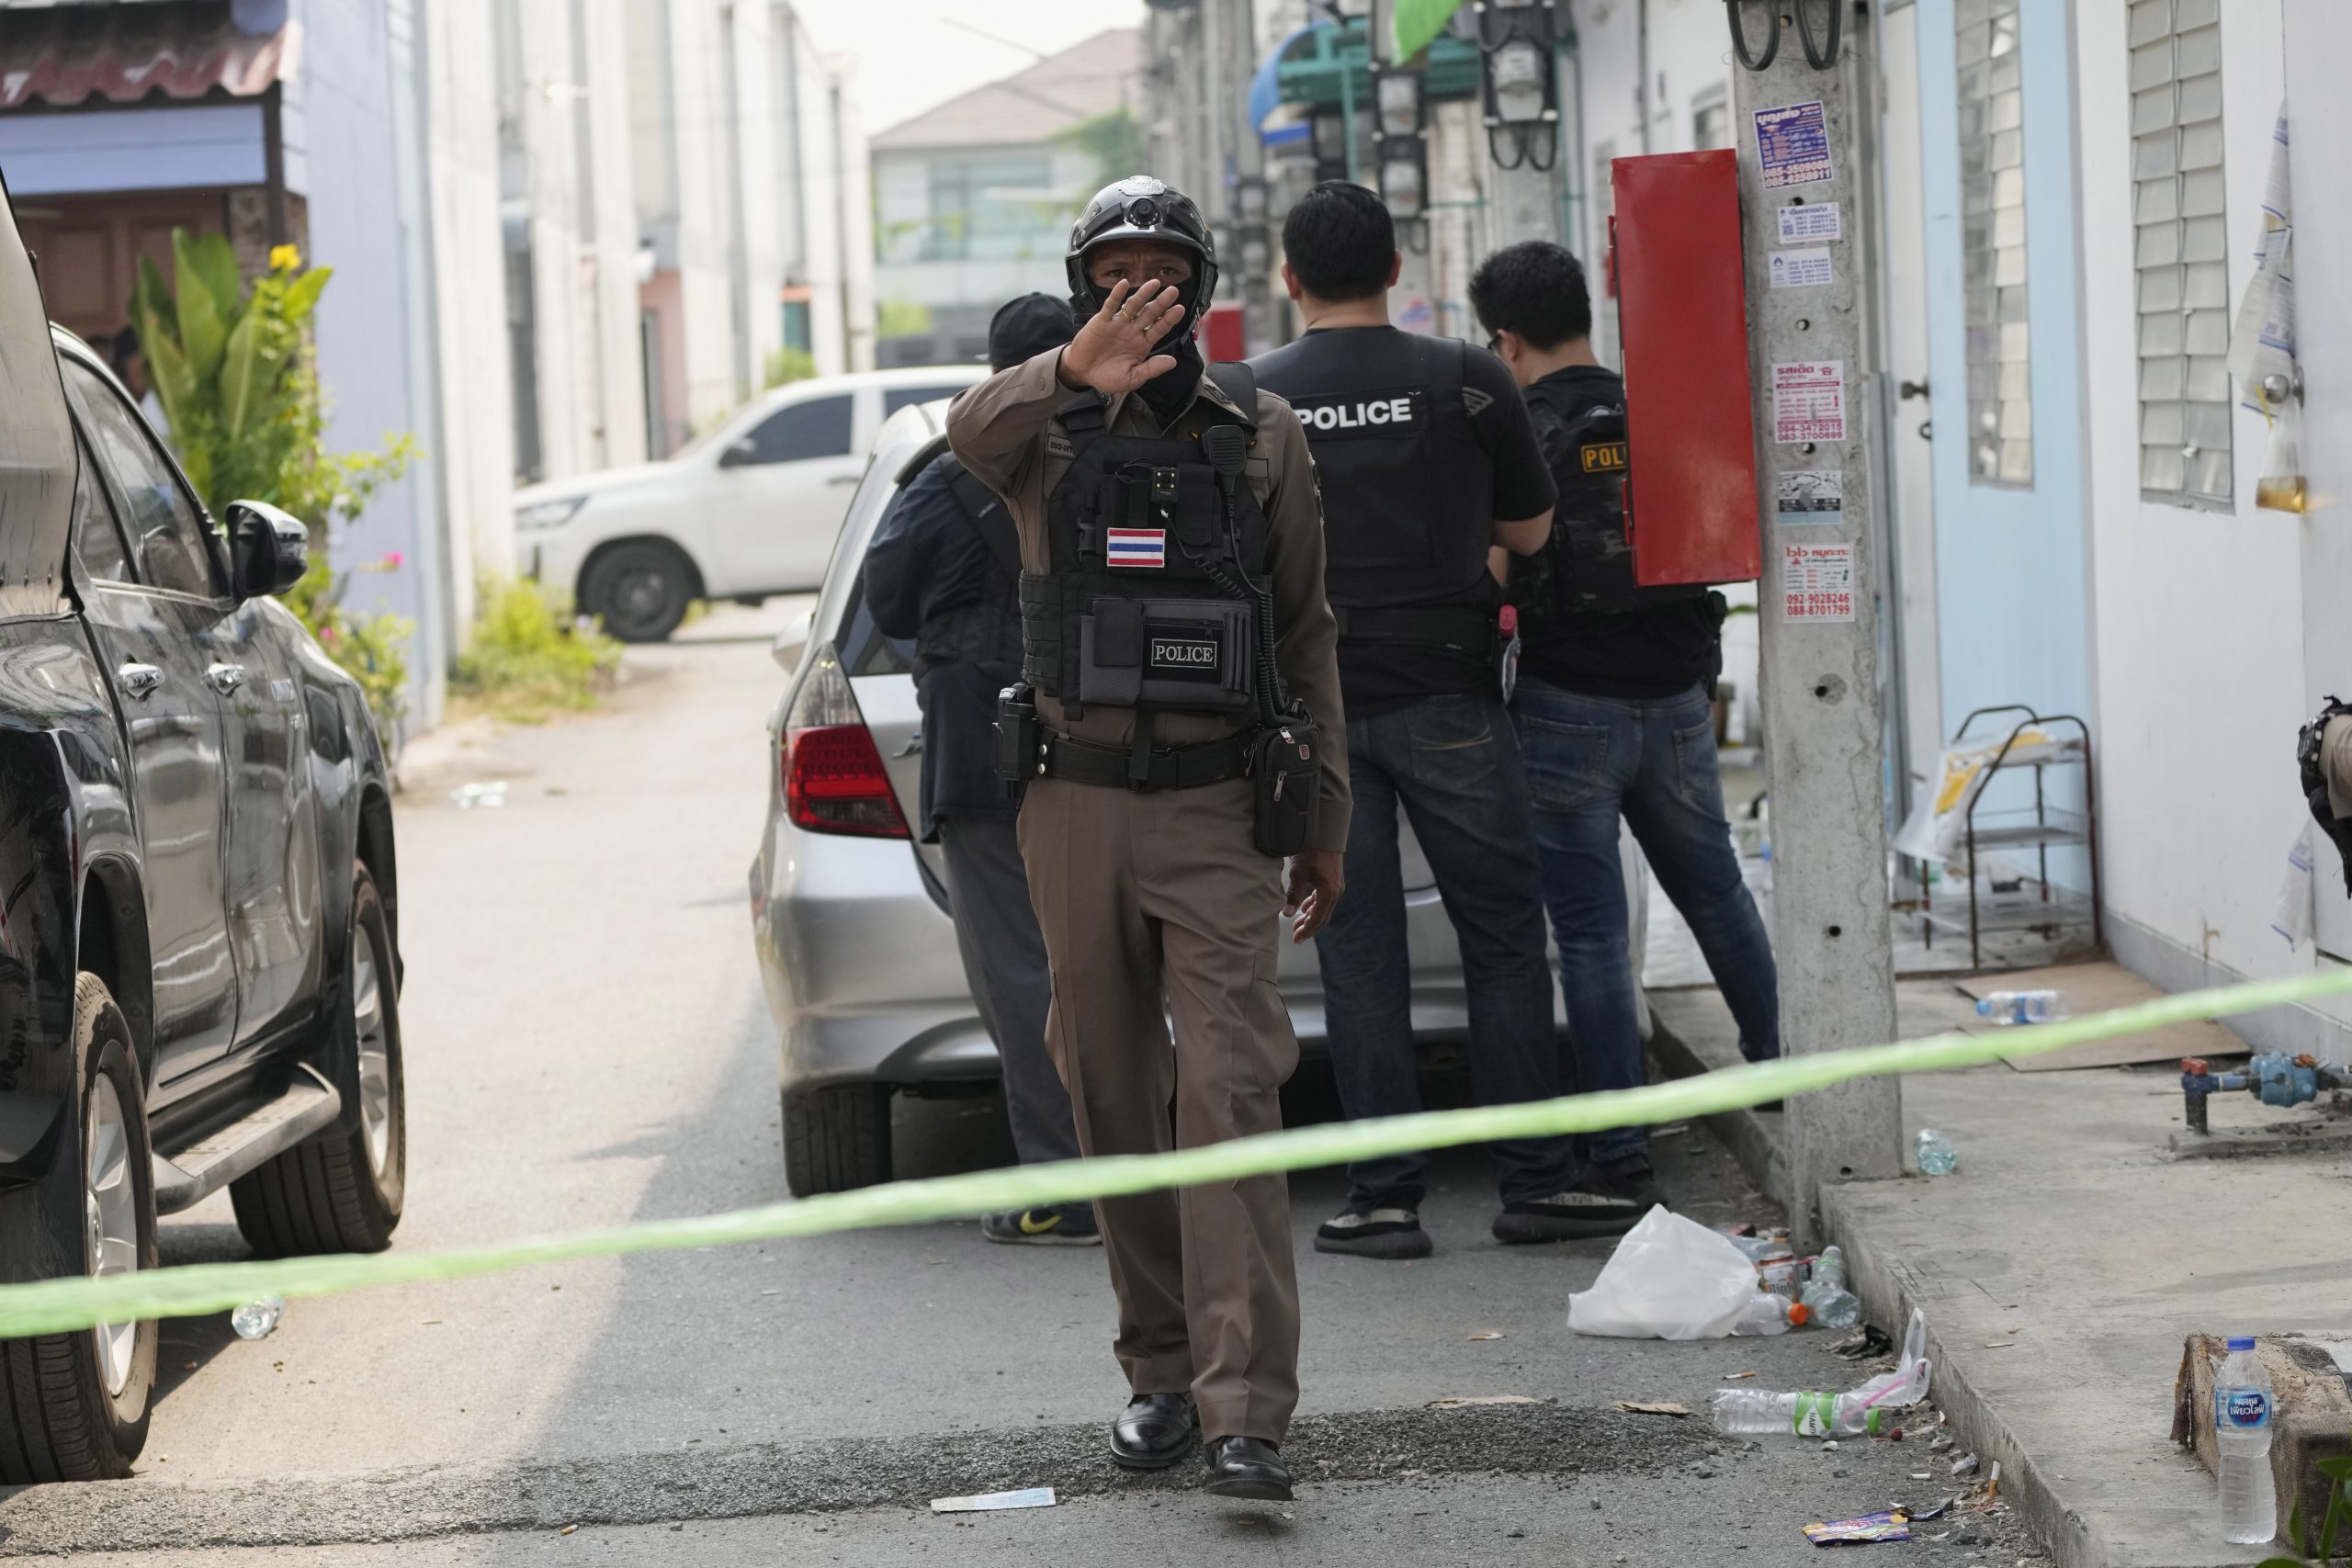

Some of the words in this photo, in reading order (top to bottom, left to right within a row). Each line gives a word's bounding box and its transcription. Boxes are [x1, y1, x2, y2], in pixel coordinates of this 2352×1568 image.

[1293, 398, 1411, 430] POLICE
[1586, 446, 1625, 468] POL
[1154, 645, 1214, 661] POLICE
